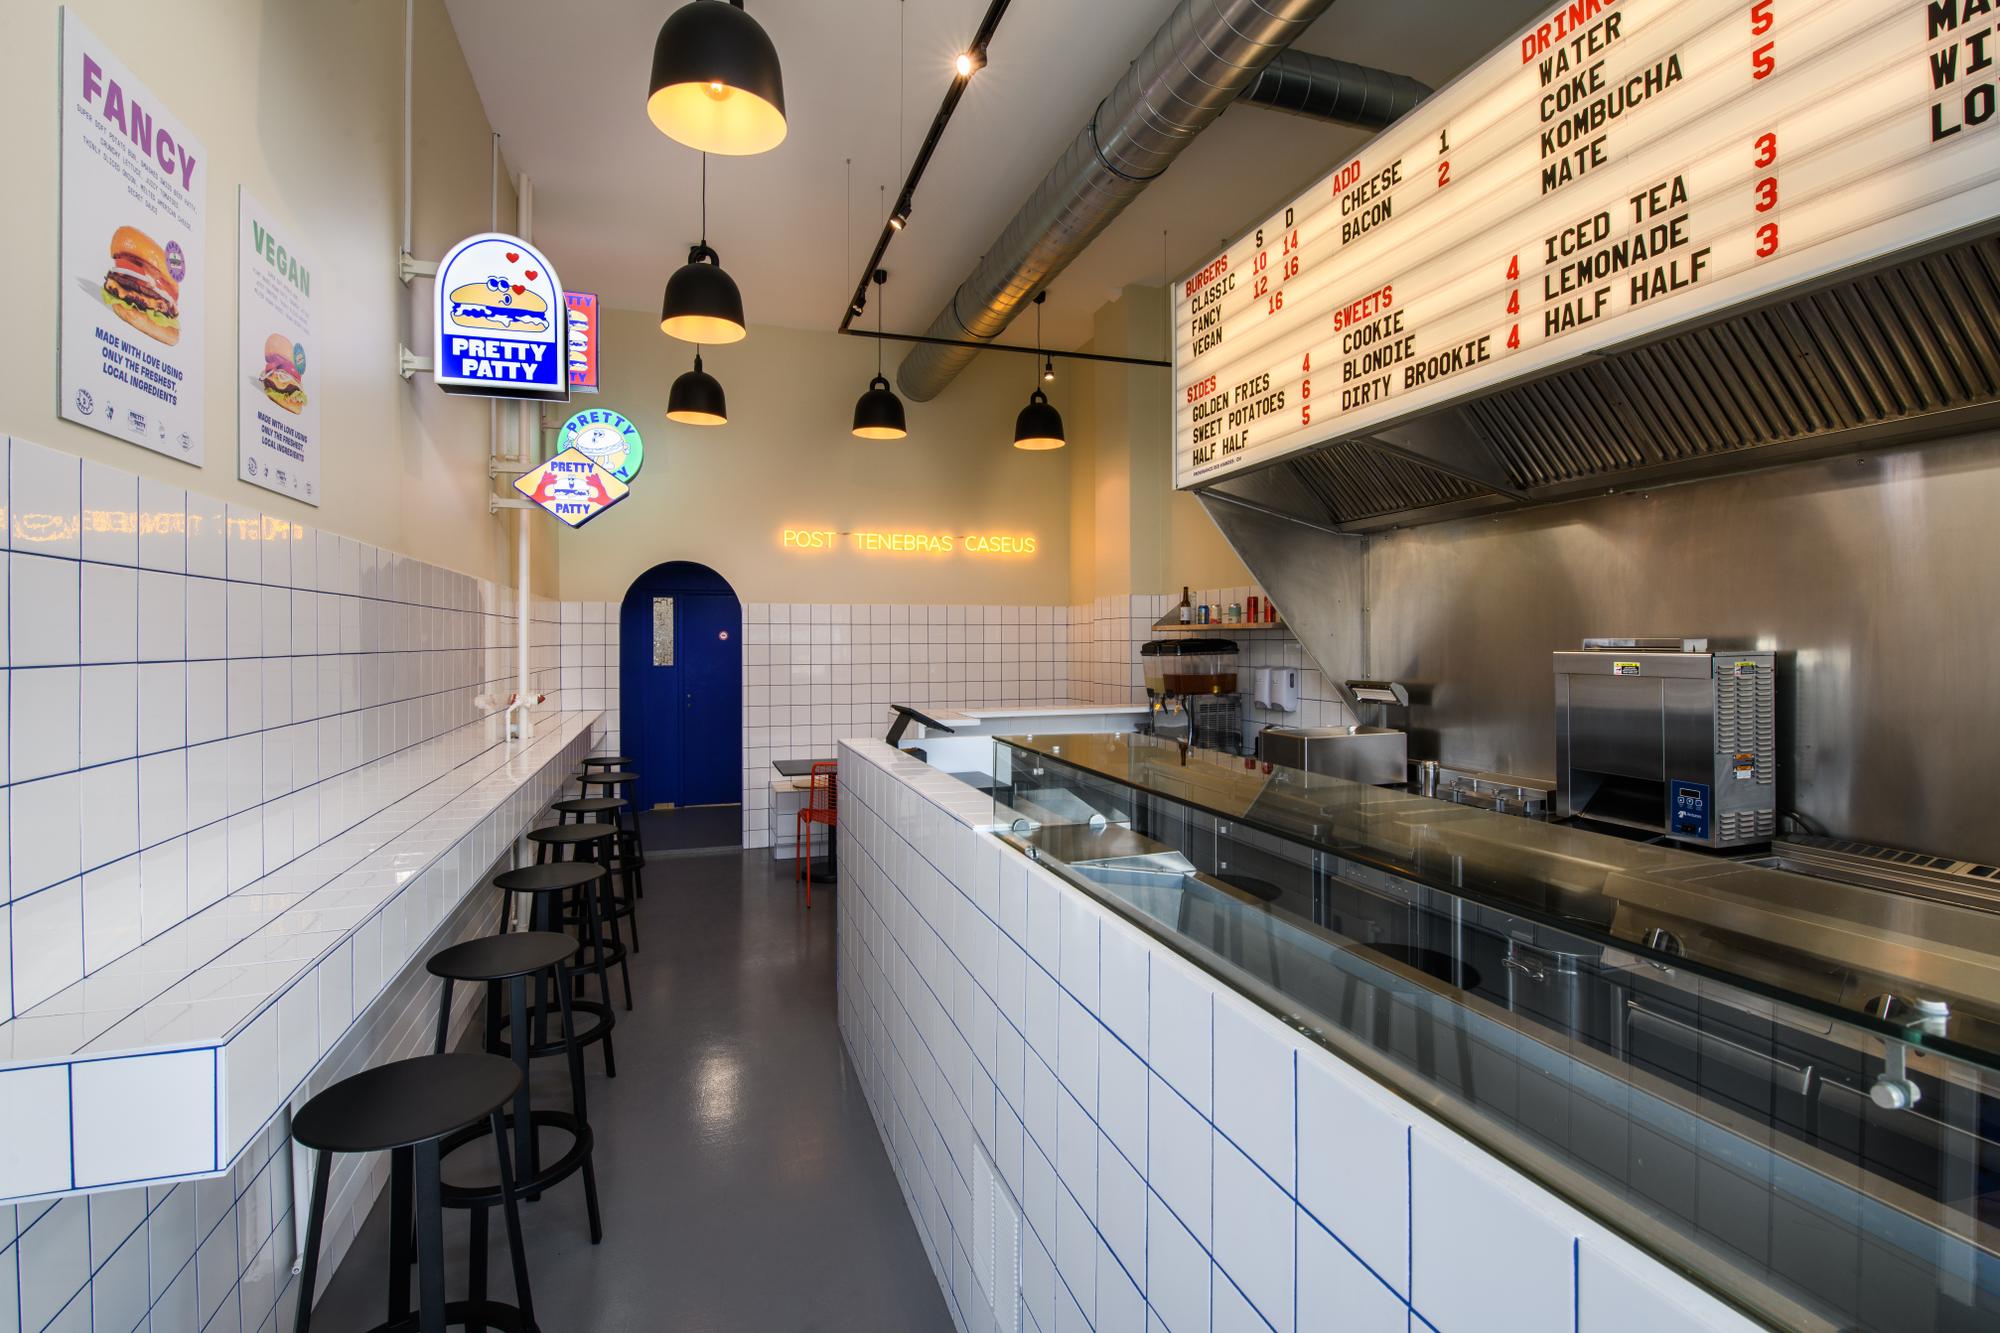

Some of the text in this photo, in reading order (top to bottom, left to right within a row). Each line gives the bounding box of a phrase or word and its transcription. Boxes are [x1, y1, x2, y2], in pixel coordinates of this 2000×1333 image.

[1522, 0, 1618, 65] DRINK
[1539, 11, 1622, 88] WATER
[1927, 0, 2000, 41] MA
[1541, 0, 1774, 159] KOMBUCHA 5
[1930, 23, 2000, 90] WI
[83, 52, 196, 192] FANCY
[1540, 59, 1605, 123] COKE
[1542, 41, 1775, 195] MATE 5
[1931, 76, 2000, 142] LO
[1333, 160, 1361, 197] ADD
[1342, 129, 1449, 216] CHEESE 1
[1342, 161, 1450, 245] BACON 2
[1545, 132, 1776, 265] ICED TEA 3
[252, 219, 310, 298] VEGAN
[1186, 207, 1294, 298] BURGERS S D
[1192, 229, 1298, 314] CLASSIC 10 14
[1545, 176, 1778, 302] LEMONADE 3
[566, 295, 592, 307] TTY
[1192, 255, 1299, 337] FANCY 12 16
[1334, 285, 1392, 332] SWEETS
[1343, 254, 1520, 355] COOKIE 4
[1545, 222, 1779, 338] HALF HALF 3
[95, 326, 183, 381] MADE WITH LOVE USING
[452, 337, 547, 361] PRETTY
[1192, 290, 1283, 357] VEGAN 16
[1343, 289, 1520, 384] BLONDIE 4
[102, 347, 124, 364] ONLY
[125, 357, 142, 373] THE
[103, 362, 178, 406] LOCAL INGREDIENTS
[462, 358, 538, 380] PATTY
[1187, 375, 1216, 403] SIDES
[1193, 352, 1310, 422] GOLDEN FRIES 4
[1342, 323, 1520, 412] DIRTY BROOKIE 4
[258, 410, 271, 425] MADE
[271, 418, 283, 431] WITH
[284, 424, 294, 437] LOVE
[261, 424, 274, 437] ONLY
[274, 430, 282, 442] THE
[566, 411, 636, 435] PRETTY
[1193, 380, 1310, 444] SWEET POTATOES 6
[1193, 404, 1310, 466] HALF HALF 5
[262, 436, 304, 463] LOCAL INGREDIENTS
[550, 461, 594, 473] PRETTY
[555, 503, 590, 514] PATTY
[784, 529, 1036, 553] POST TENEBRAS CASEUS
